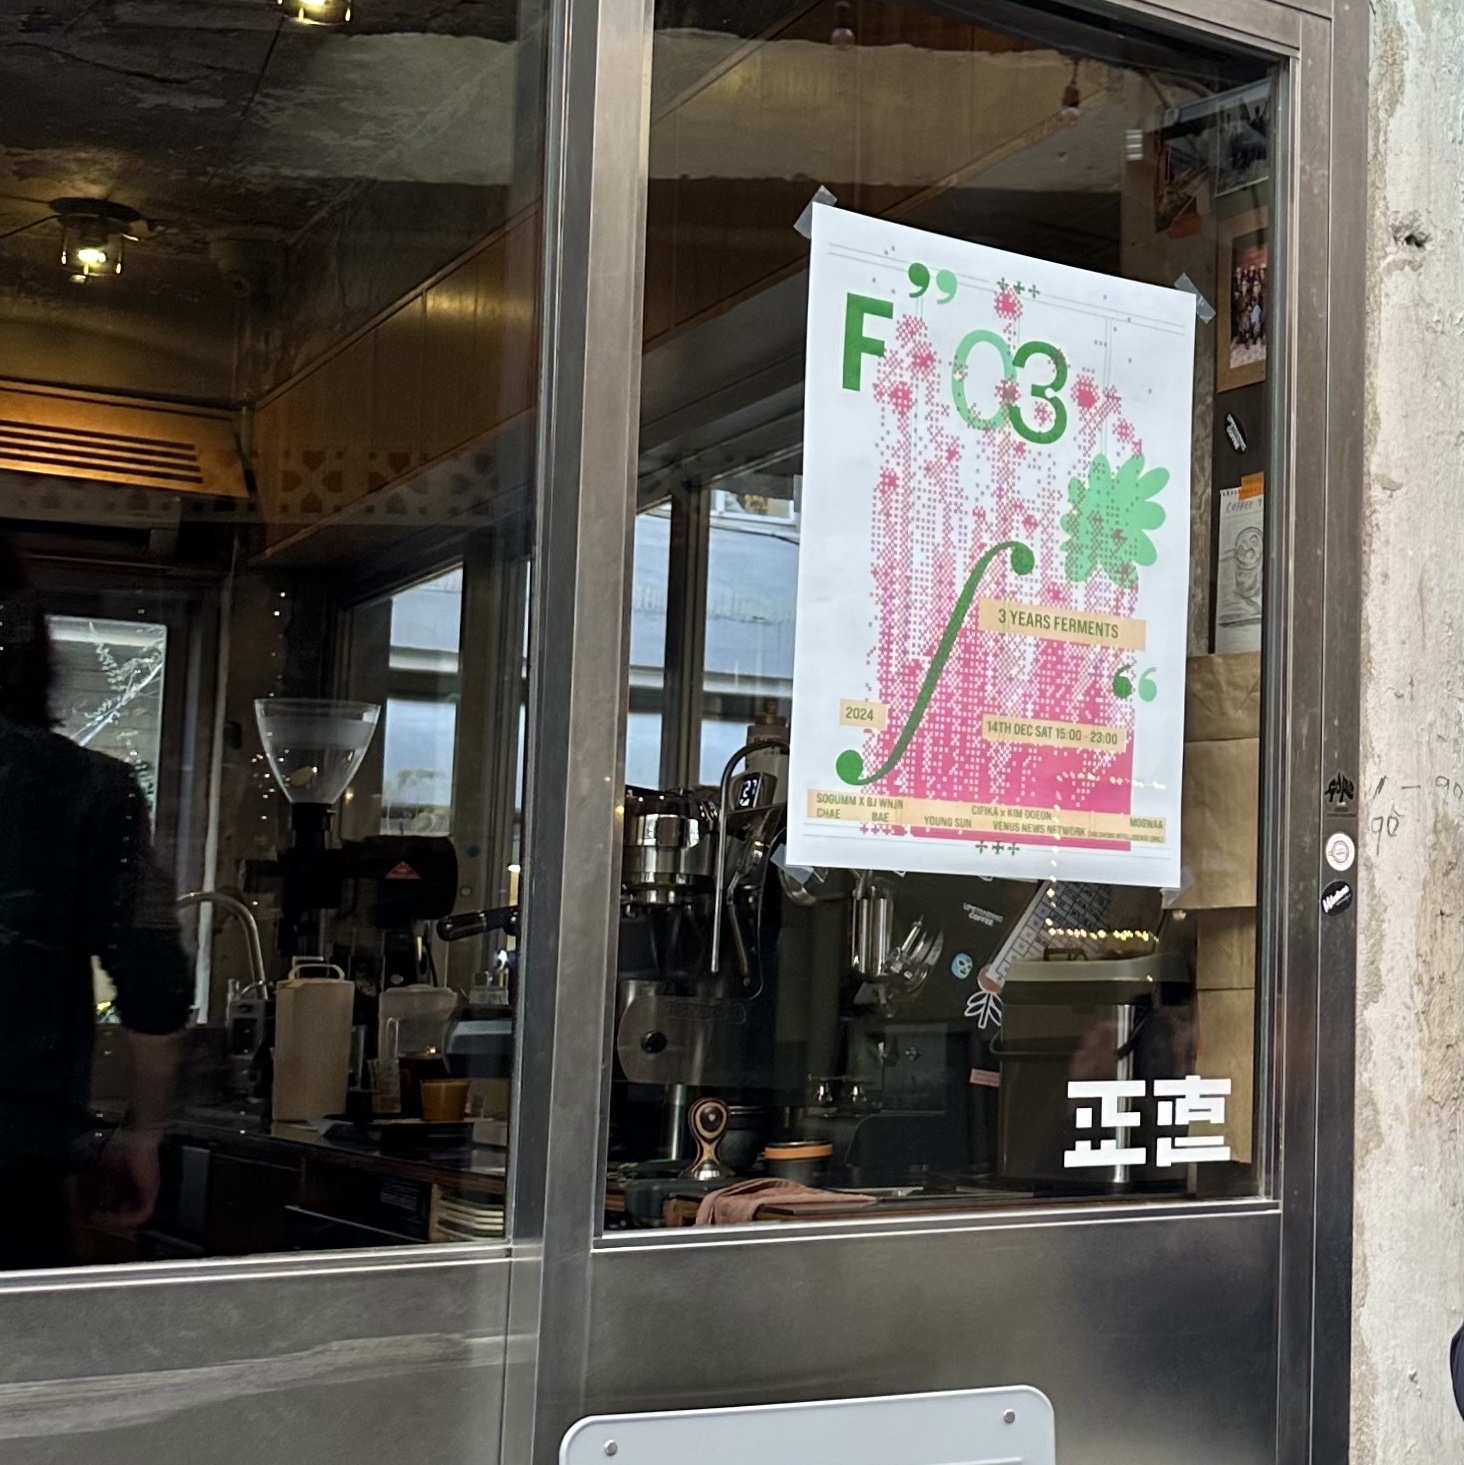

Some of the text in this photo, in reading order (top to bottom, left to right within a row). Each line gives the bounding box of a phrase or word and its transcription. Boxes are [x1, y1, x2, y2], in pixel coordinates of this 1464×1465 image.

[951, 329, 1068, 445] 03
[998, 608, 1119, 639] 3 YEARS FERMENTS
[845, 706, 874, 721] 2024
[986, 720, 1012, 734] 14TH
[1013, 722, 1033, 737] DEC
[1035, 726, 1053, 739] SAT
[1055, 728, 1082, 742] 15:00
[1090, 731, 1118, 745] 23:00
[816, 793, 857, 806] SOGUMM
[858, 796, 865, 807] X
[867, 797, 878, 808] BJ
[816, 807, 890, 823] CHAE BAE
[1007, 807, 1023, 819] KIM
[924, 815, 972, 828] YOUNG SUN
[992, 820, 1021, 832] VENUS
[1021, 822, 1046, 834] NEWS
[1046, 824, 1086, 837] NETWORK
[1064, 1075, 1232, 1168] 正直
